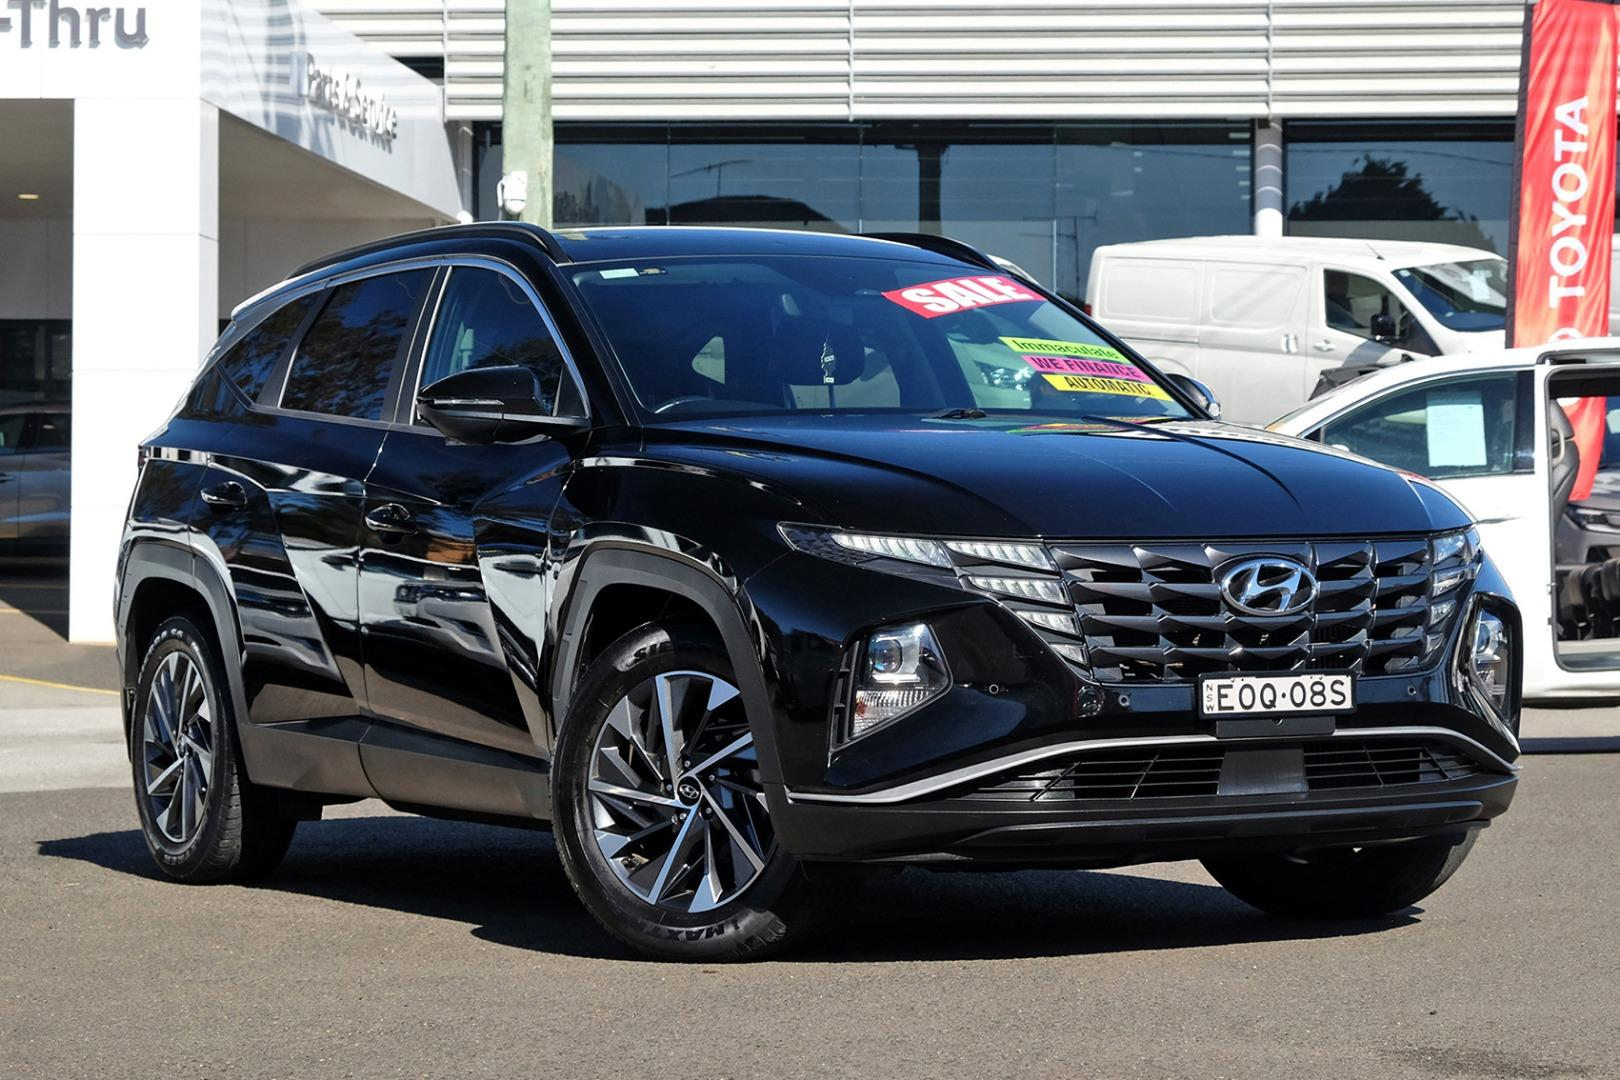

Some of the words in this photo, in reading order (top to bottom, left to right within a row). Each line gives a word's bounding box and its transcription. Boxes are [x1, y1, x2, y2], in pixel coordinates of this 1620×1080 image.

[303, 51, 339, 107] Parts
[350, 79, 398, 140] Service
[1548, 96, 1589, 309] TOYOTA
[901, 277, 1034, 313] SALE
[1012, 339, 1120, 360] Immaculate
[1030, 356, 1063, 370] WE
[1065, 358, 1143, 378] FINANCE
[1064, 376, 1151, 395] AUTOMATIC
